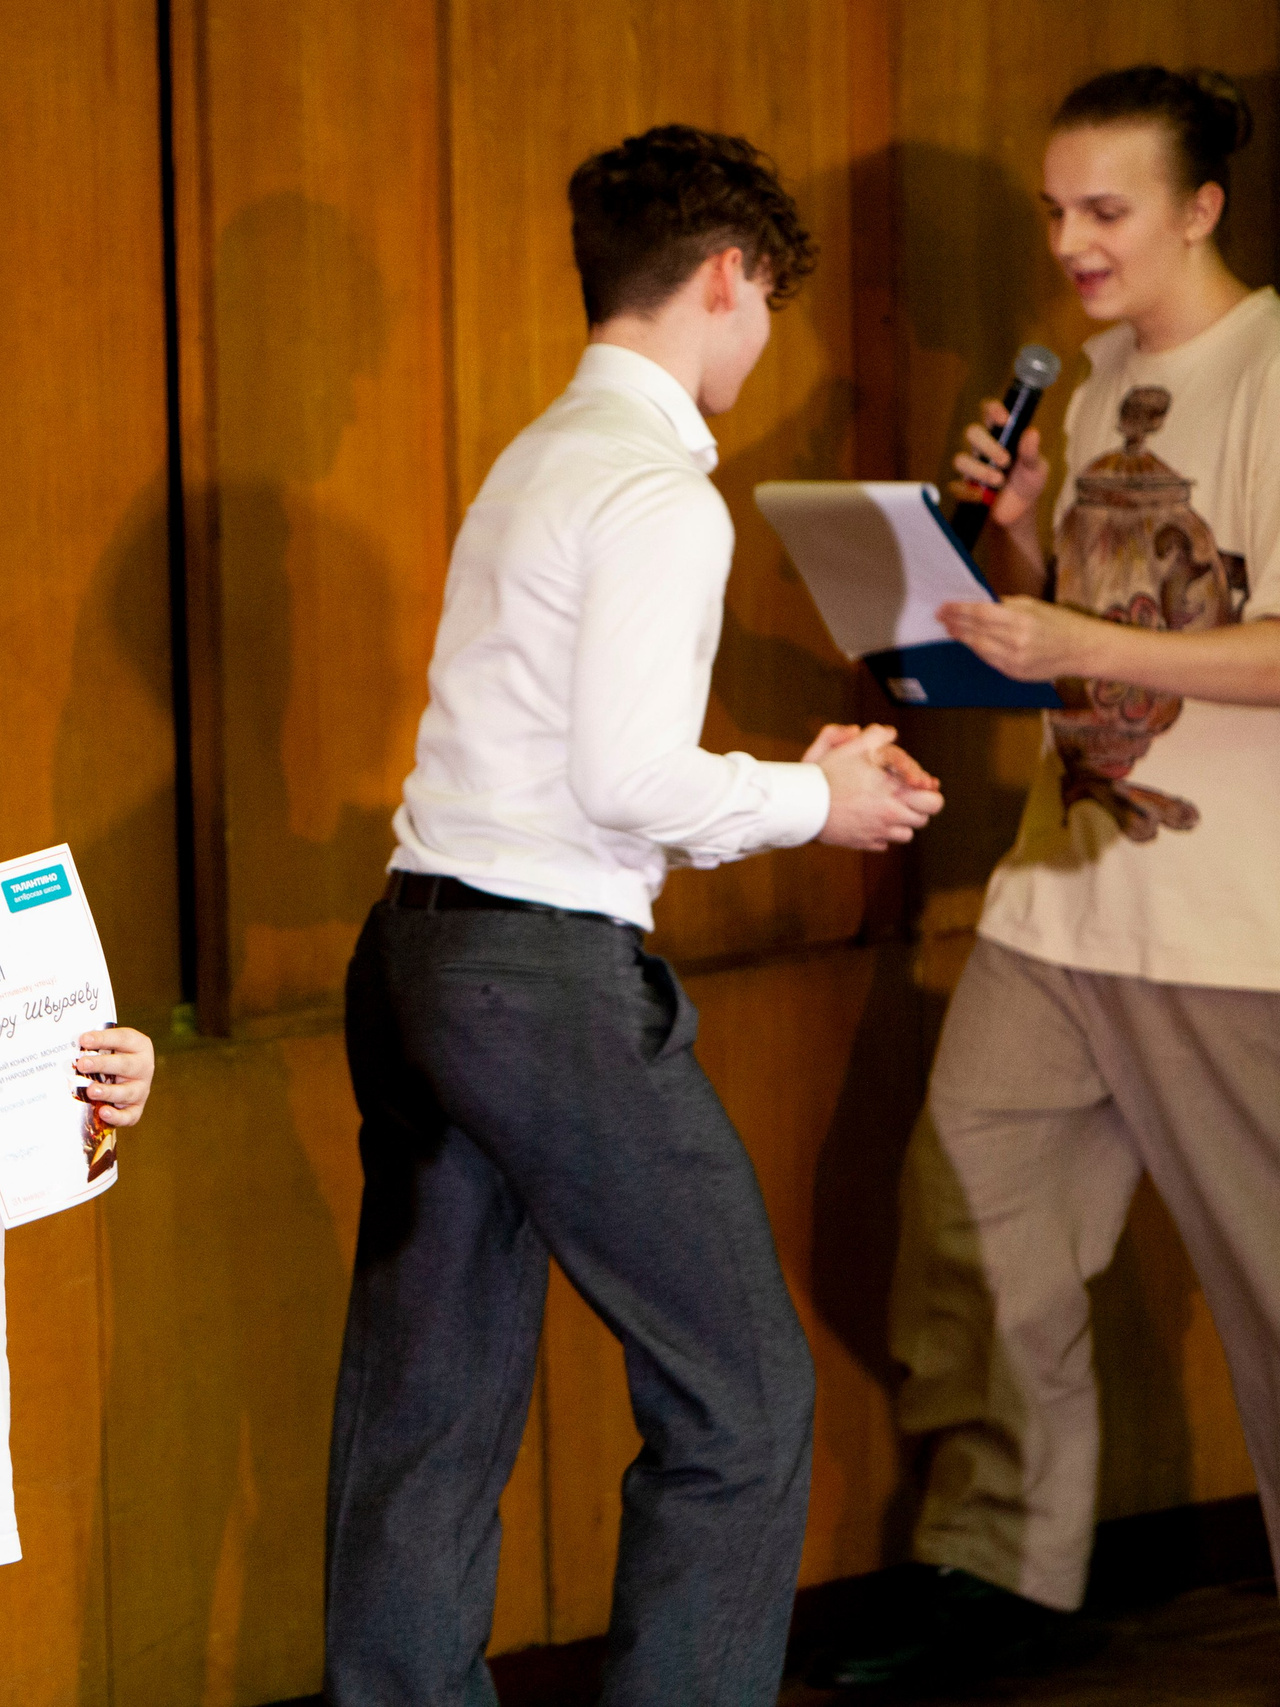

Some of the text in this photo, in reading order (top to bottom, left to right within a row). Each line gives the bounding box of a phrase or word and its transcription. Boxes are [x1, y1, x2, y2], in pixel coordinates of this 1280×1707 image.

[10, 873, 57, 893] ТАЛАНТИНО
[44, 884, 61, 894] школа
[10, 1053, 39, 1067] КОНКУРС
[5, 1068, 36, 1082] НАРОДОВ
